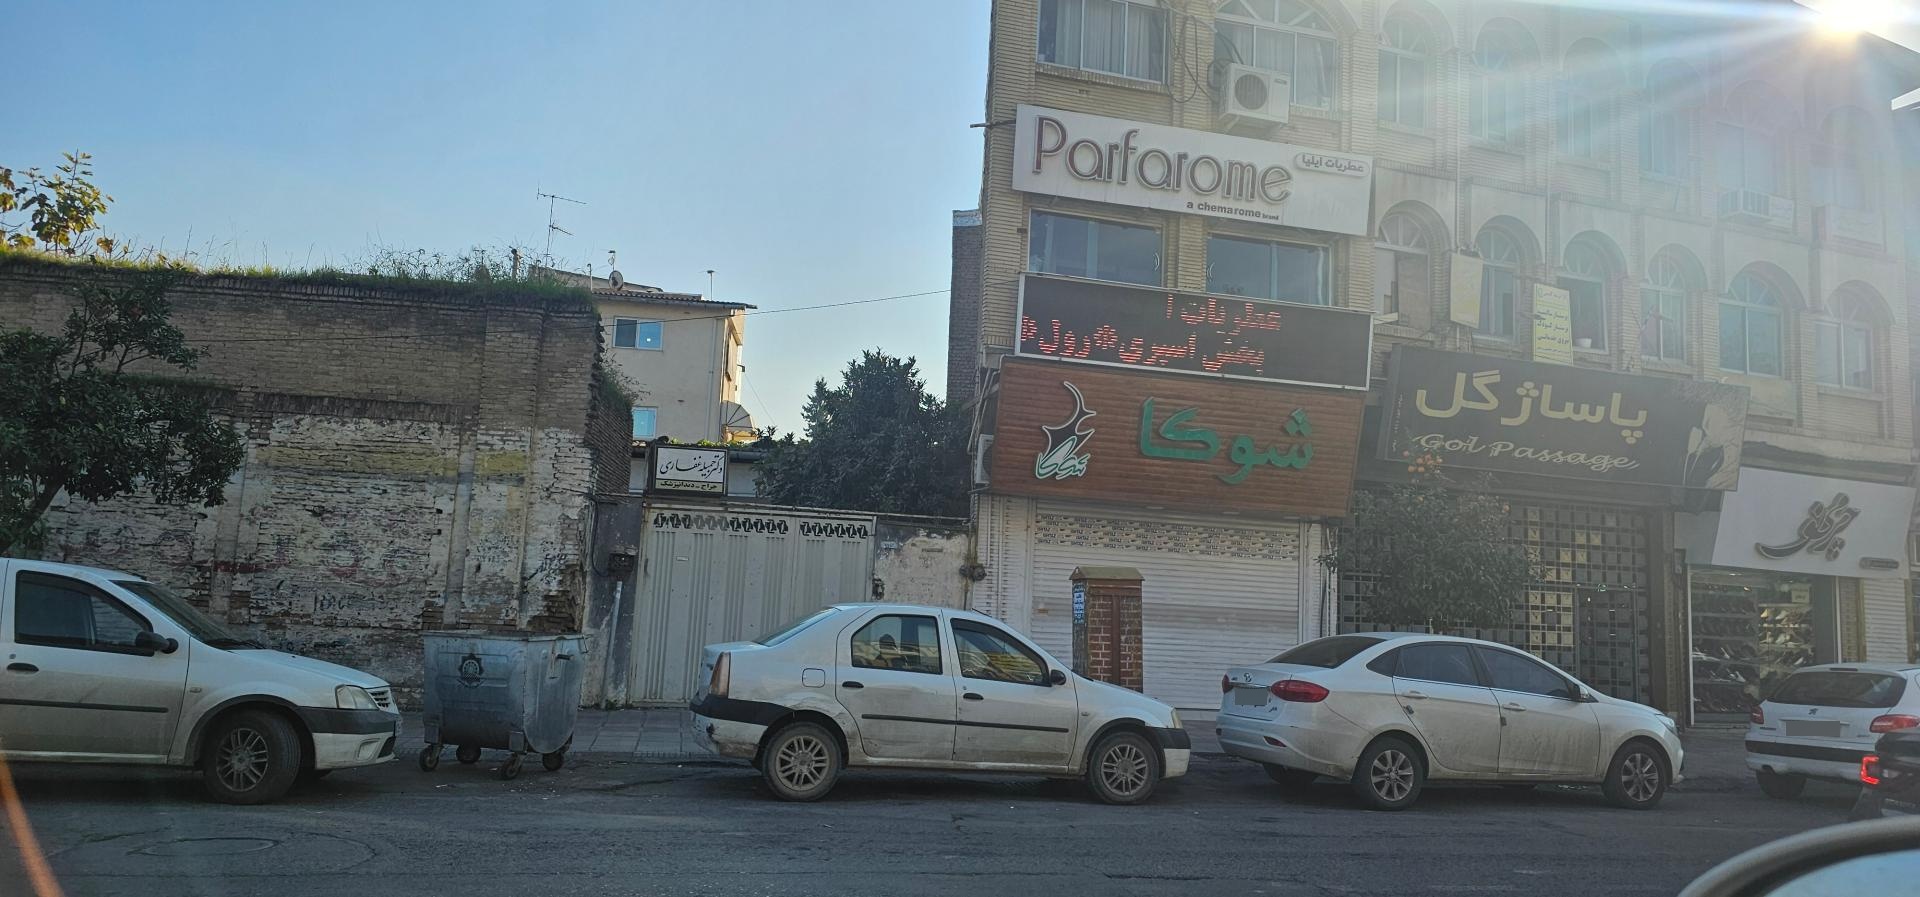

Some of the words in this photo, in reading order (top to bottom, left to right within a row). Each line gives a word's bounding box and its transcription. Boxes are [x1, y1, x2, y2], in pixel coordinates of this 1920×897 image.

[1032, 114, 1293, 204] Parfarome
[1302, 154, 1323, 168] ایلیا
[1325, 159, 1364, 173] عطریات
[1186, 200, 1194, 209] a
[1197, 201, 1262, 219] chemarome
[1415, 369, 1500, 419] گل
[1500, 381, 1648, 445] پاساژ
[1139, 396, 1315, 485] شوکا
[1412, 433, 1488, 455] Gol
[1489, 440, 1642, 473] Passage
[660, 455, 702, 475] غفاری
[705, 454, 724, 479] دکتر
[660, 480, 695, 488] دندانپزشک
